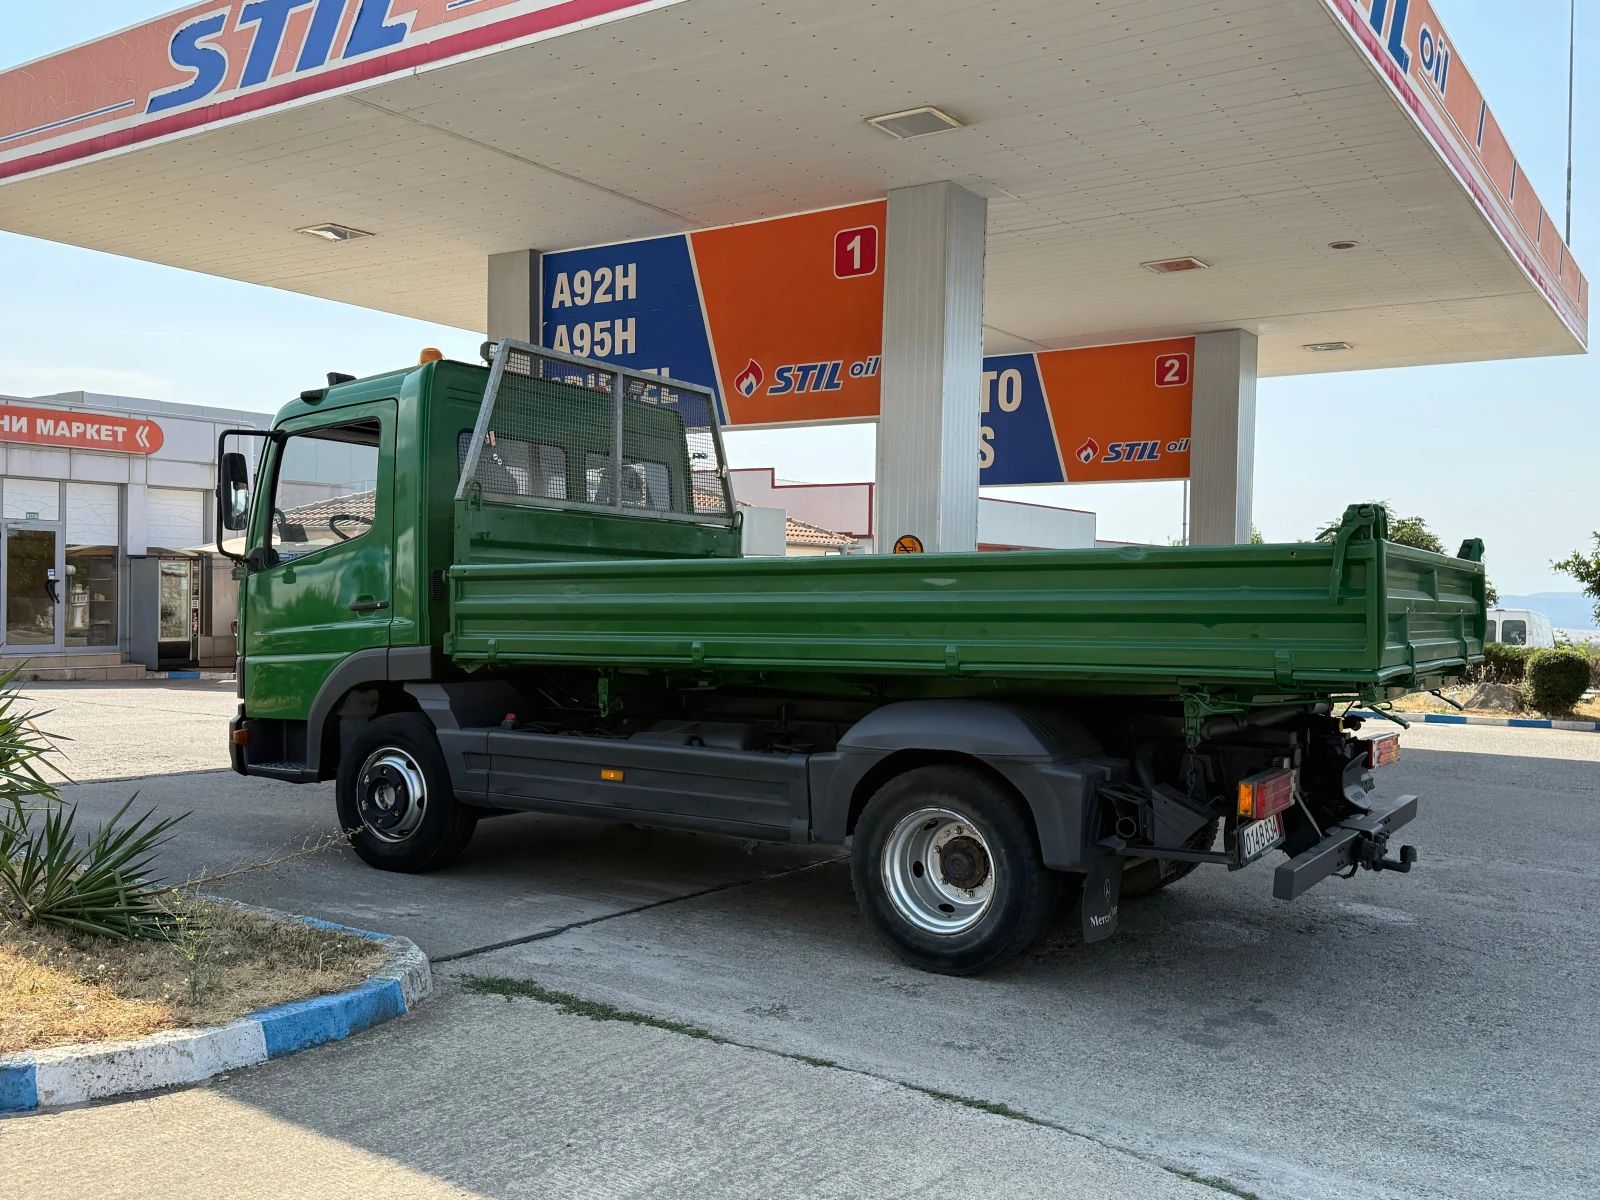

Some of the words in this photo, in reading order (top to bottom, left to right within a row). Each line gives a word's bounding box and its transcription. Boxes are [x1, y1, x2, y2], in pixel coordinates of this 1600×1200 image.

[145, 0, 409, 115] STIL
[1419, 23, 1450, 99] oil
[846, 235, 861, 269] 1
[551, 263, 637, 309] A92H
[552, 317, 636, 358] A95H
[767, 361, 843, 395] STIL
[850, 355, 881, 378] oil
[1164, 359, 1180, 382] 2
[36, 418, 127, 442] МАРКЕТ
[1102, 440, 1161, 462] STIL
[1166, 438, 1190, 453] oil
